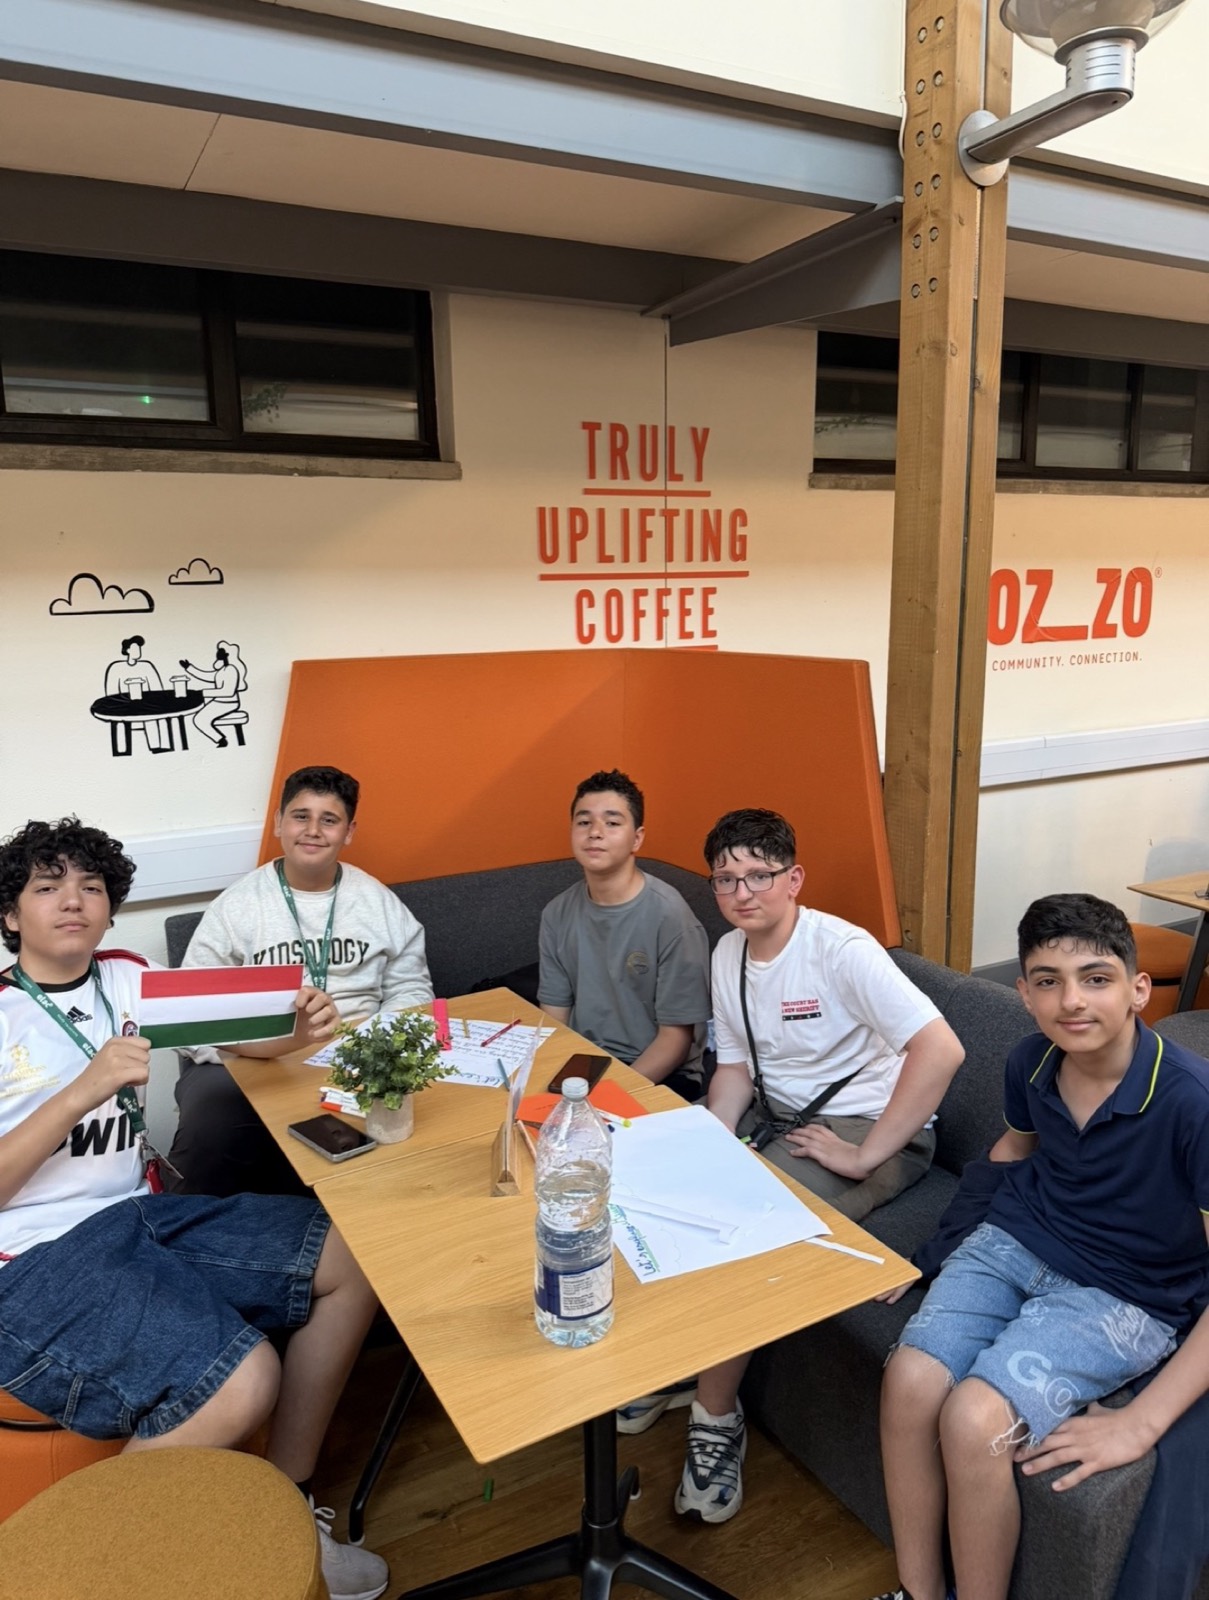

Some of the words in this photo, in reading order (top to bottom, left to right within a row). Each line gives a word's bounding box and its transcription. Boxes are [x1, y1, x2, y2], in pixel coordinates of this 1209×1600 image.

[582, 421, 710, 482] TRULY
[537, 507, 748, 564] UPLIFTING
[575, 587, 717, 645] COFFEE
[992, 655, 1064, 671] COMMUNITY.
[1069, 651, 1142, 666] CONNECTION.
